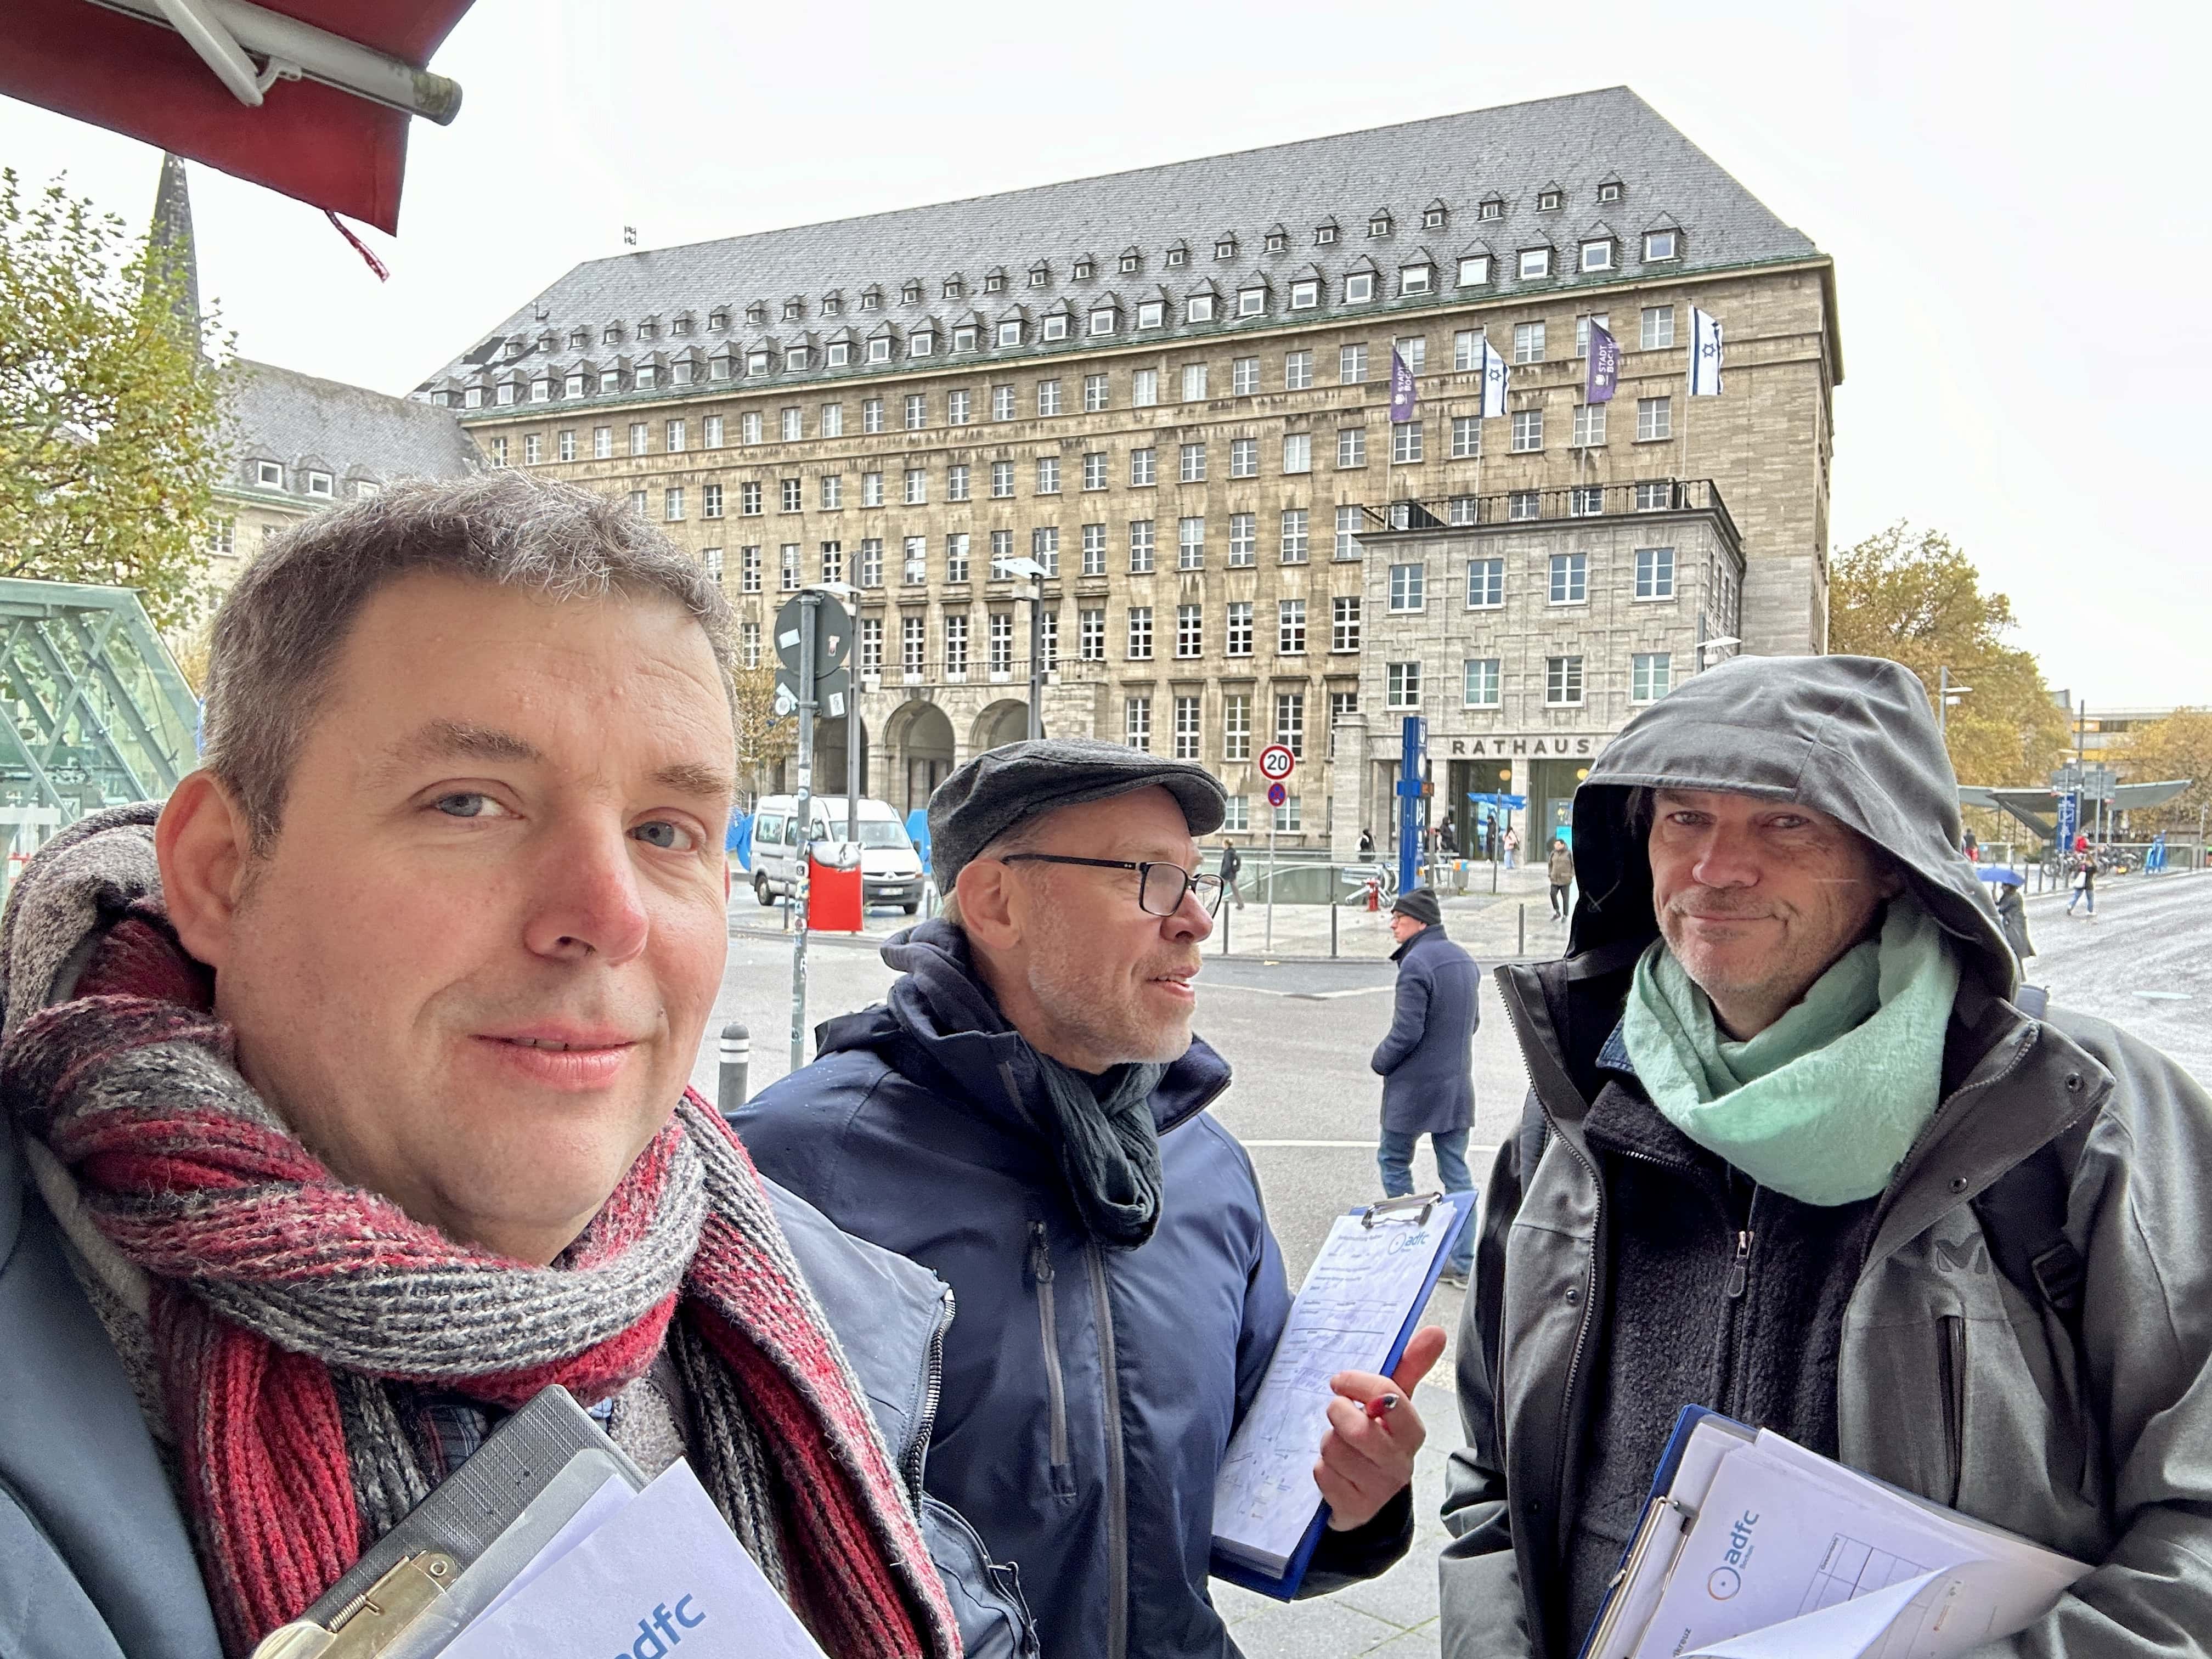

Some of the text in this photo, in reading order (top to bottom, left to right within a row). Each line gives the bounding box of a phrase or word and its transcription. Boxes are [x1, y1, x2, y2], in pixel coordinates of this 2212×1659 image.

[1599, 345, 1607, 373] STADT
[1452, 739, 1590, 755] RATHAUS
[1267, 754, 1287, 770] 20
[1405, 1231, 1429, 1246] adfc
[1724, 1510, 1759, 1565] adfc
[614, 1593, 707, 1659] dfc
